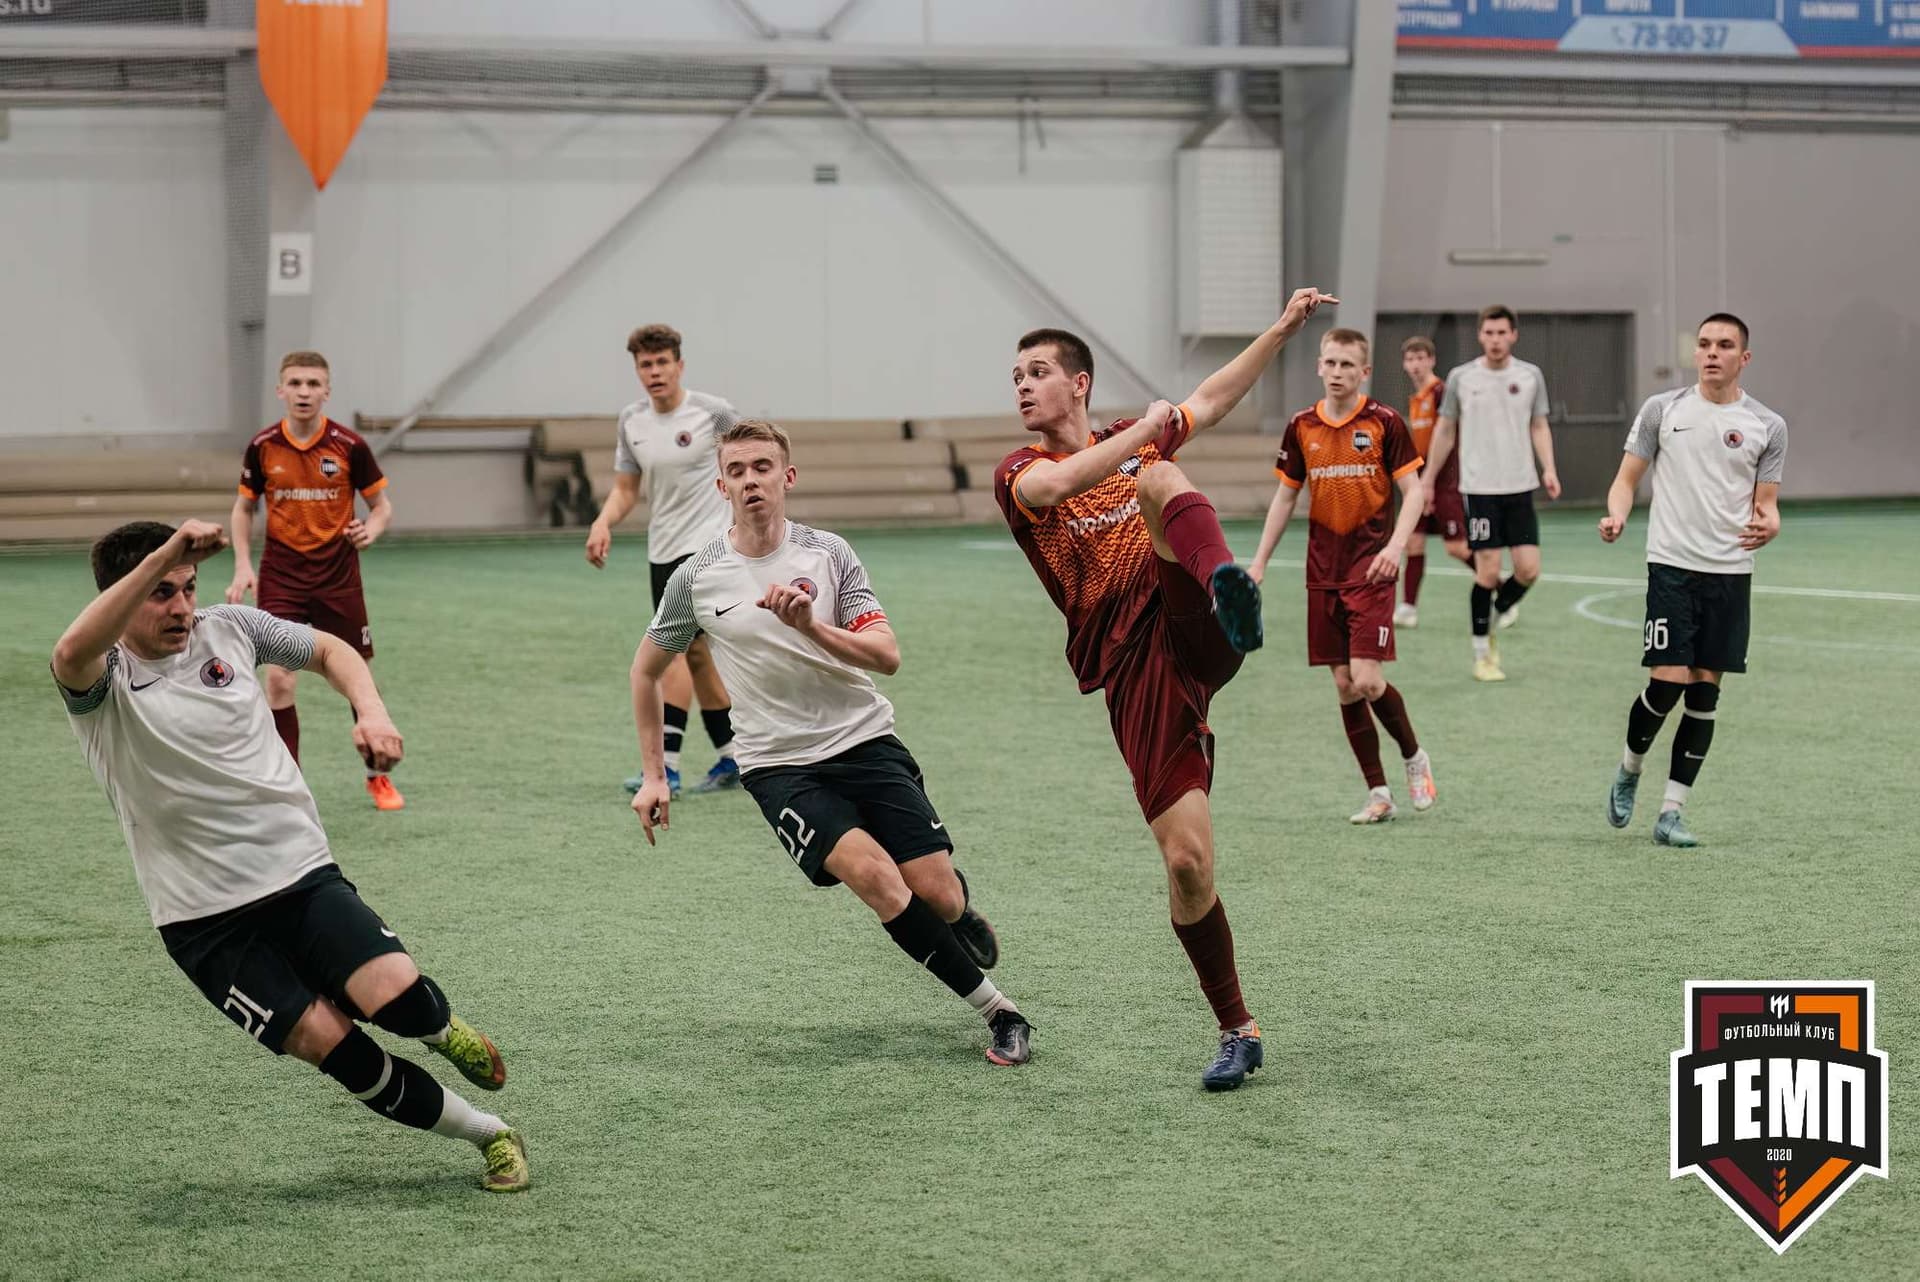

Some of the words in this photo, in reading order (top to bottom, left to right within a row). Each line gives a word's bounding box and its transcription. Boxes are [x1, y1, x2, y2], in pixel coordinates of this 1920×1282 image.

[1645, 618, 1668, 650] 96
[777, 807, 816, 864] 22
[223, 984, 274, 1041] 21
